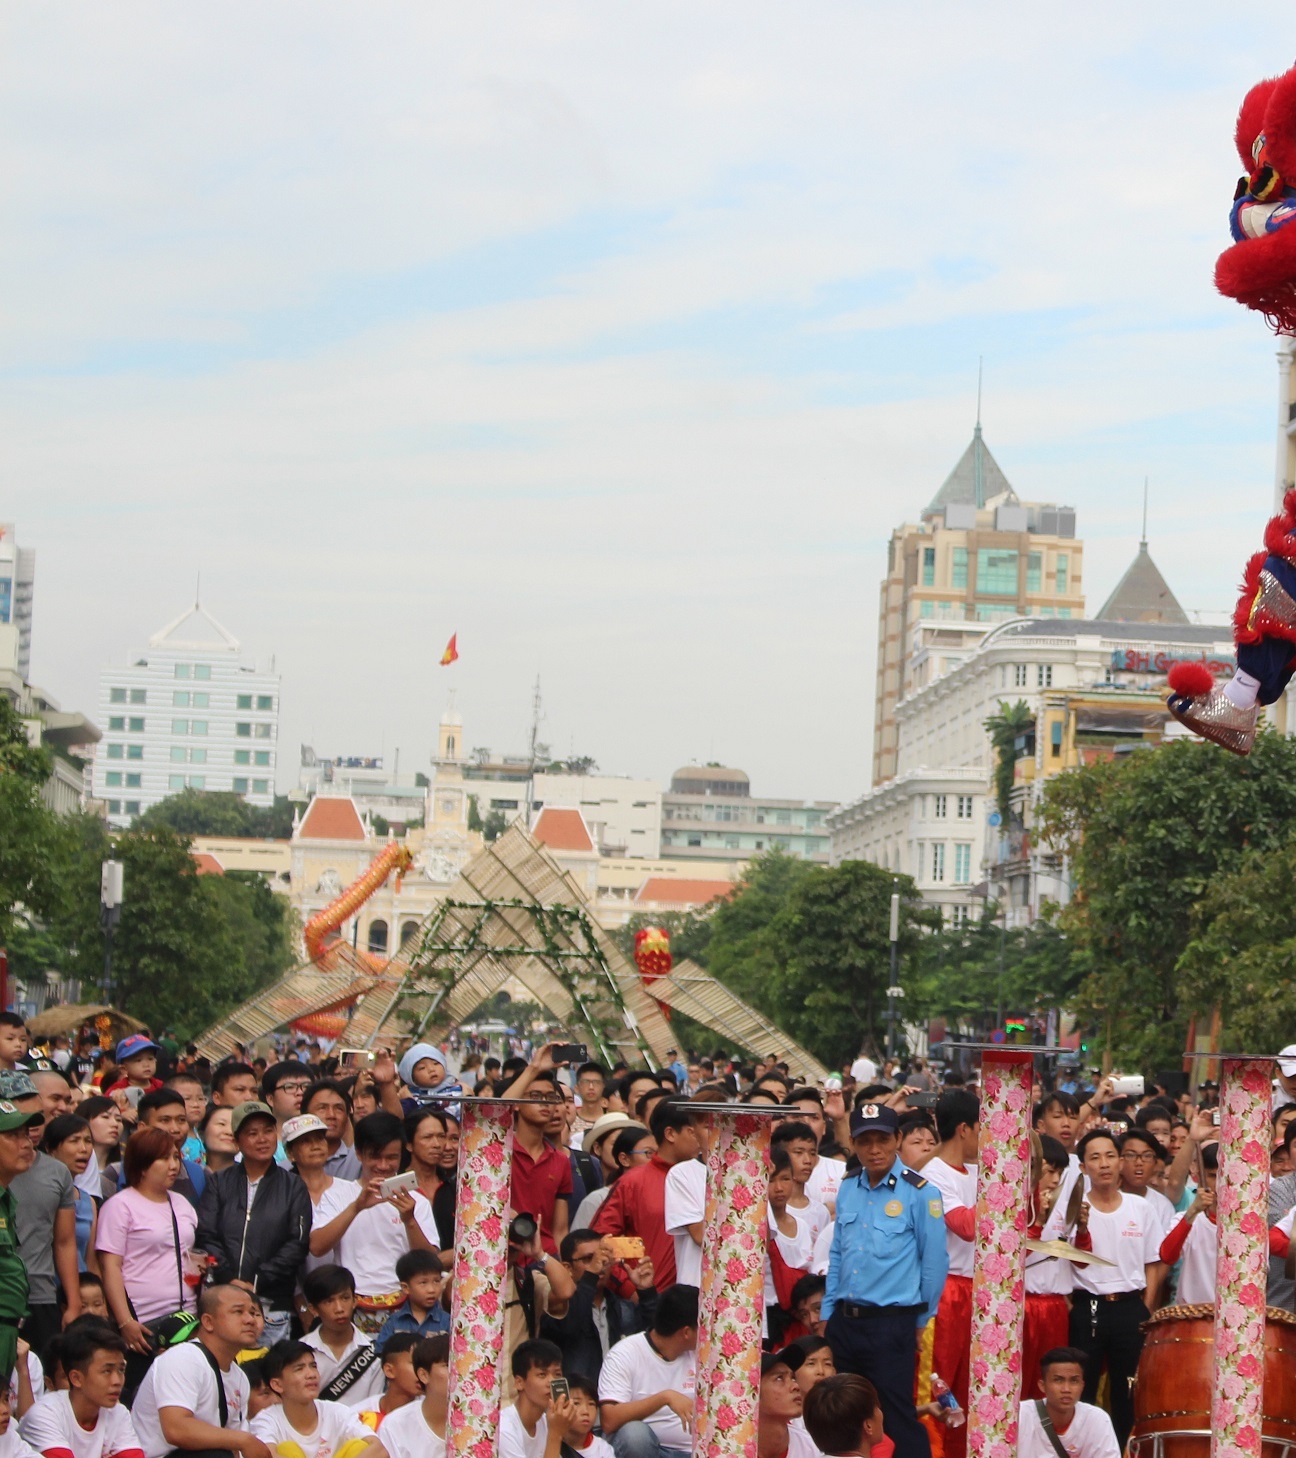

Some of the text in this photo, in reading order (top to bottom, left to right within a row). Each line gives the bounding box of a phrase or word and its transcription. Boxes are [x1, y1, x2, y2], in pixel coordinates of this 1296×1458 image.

[1125, 649, 1149, 669] SH
[330, 1343, 376, 1396] NEW YORK
